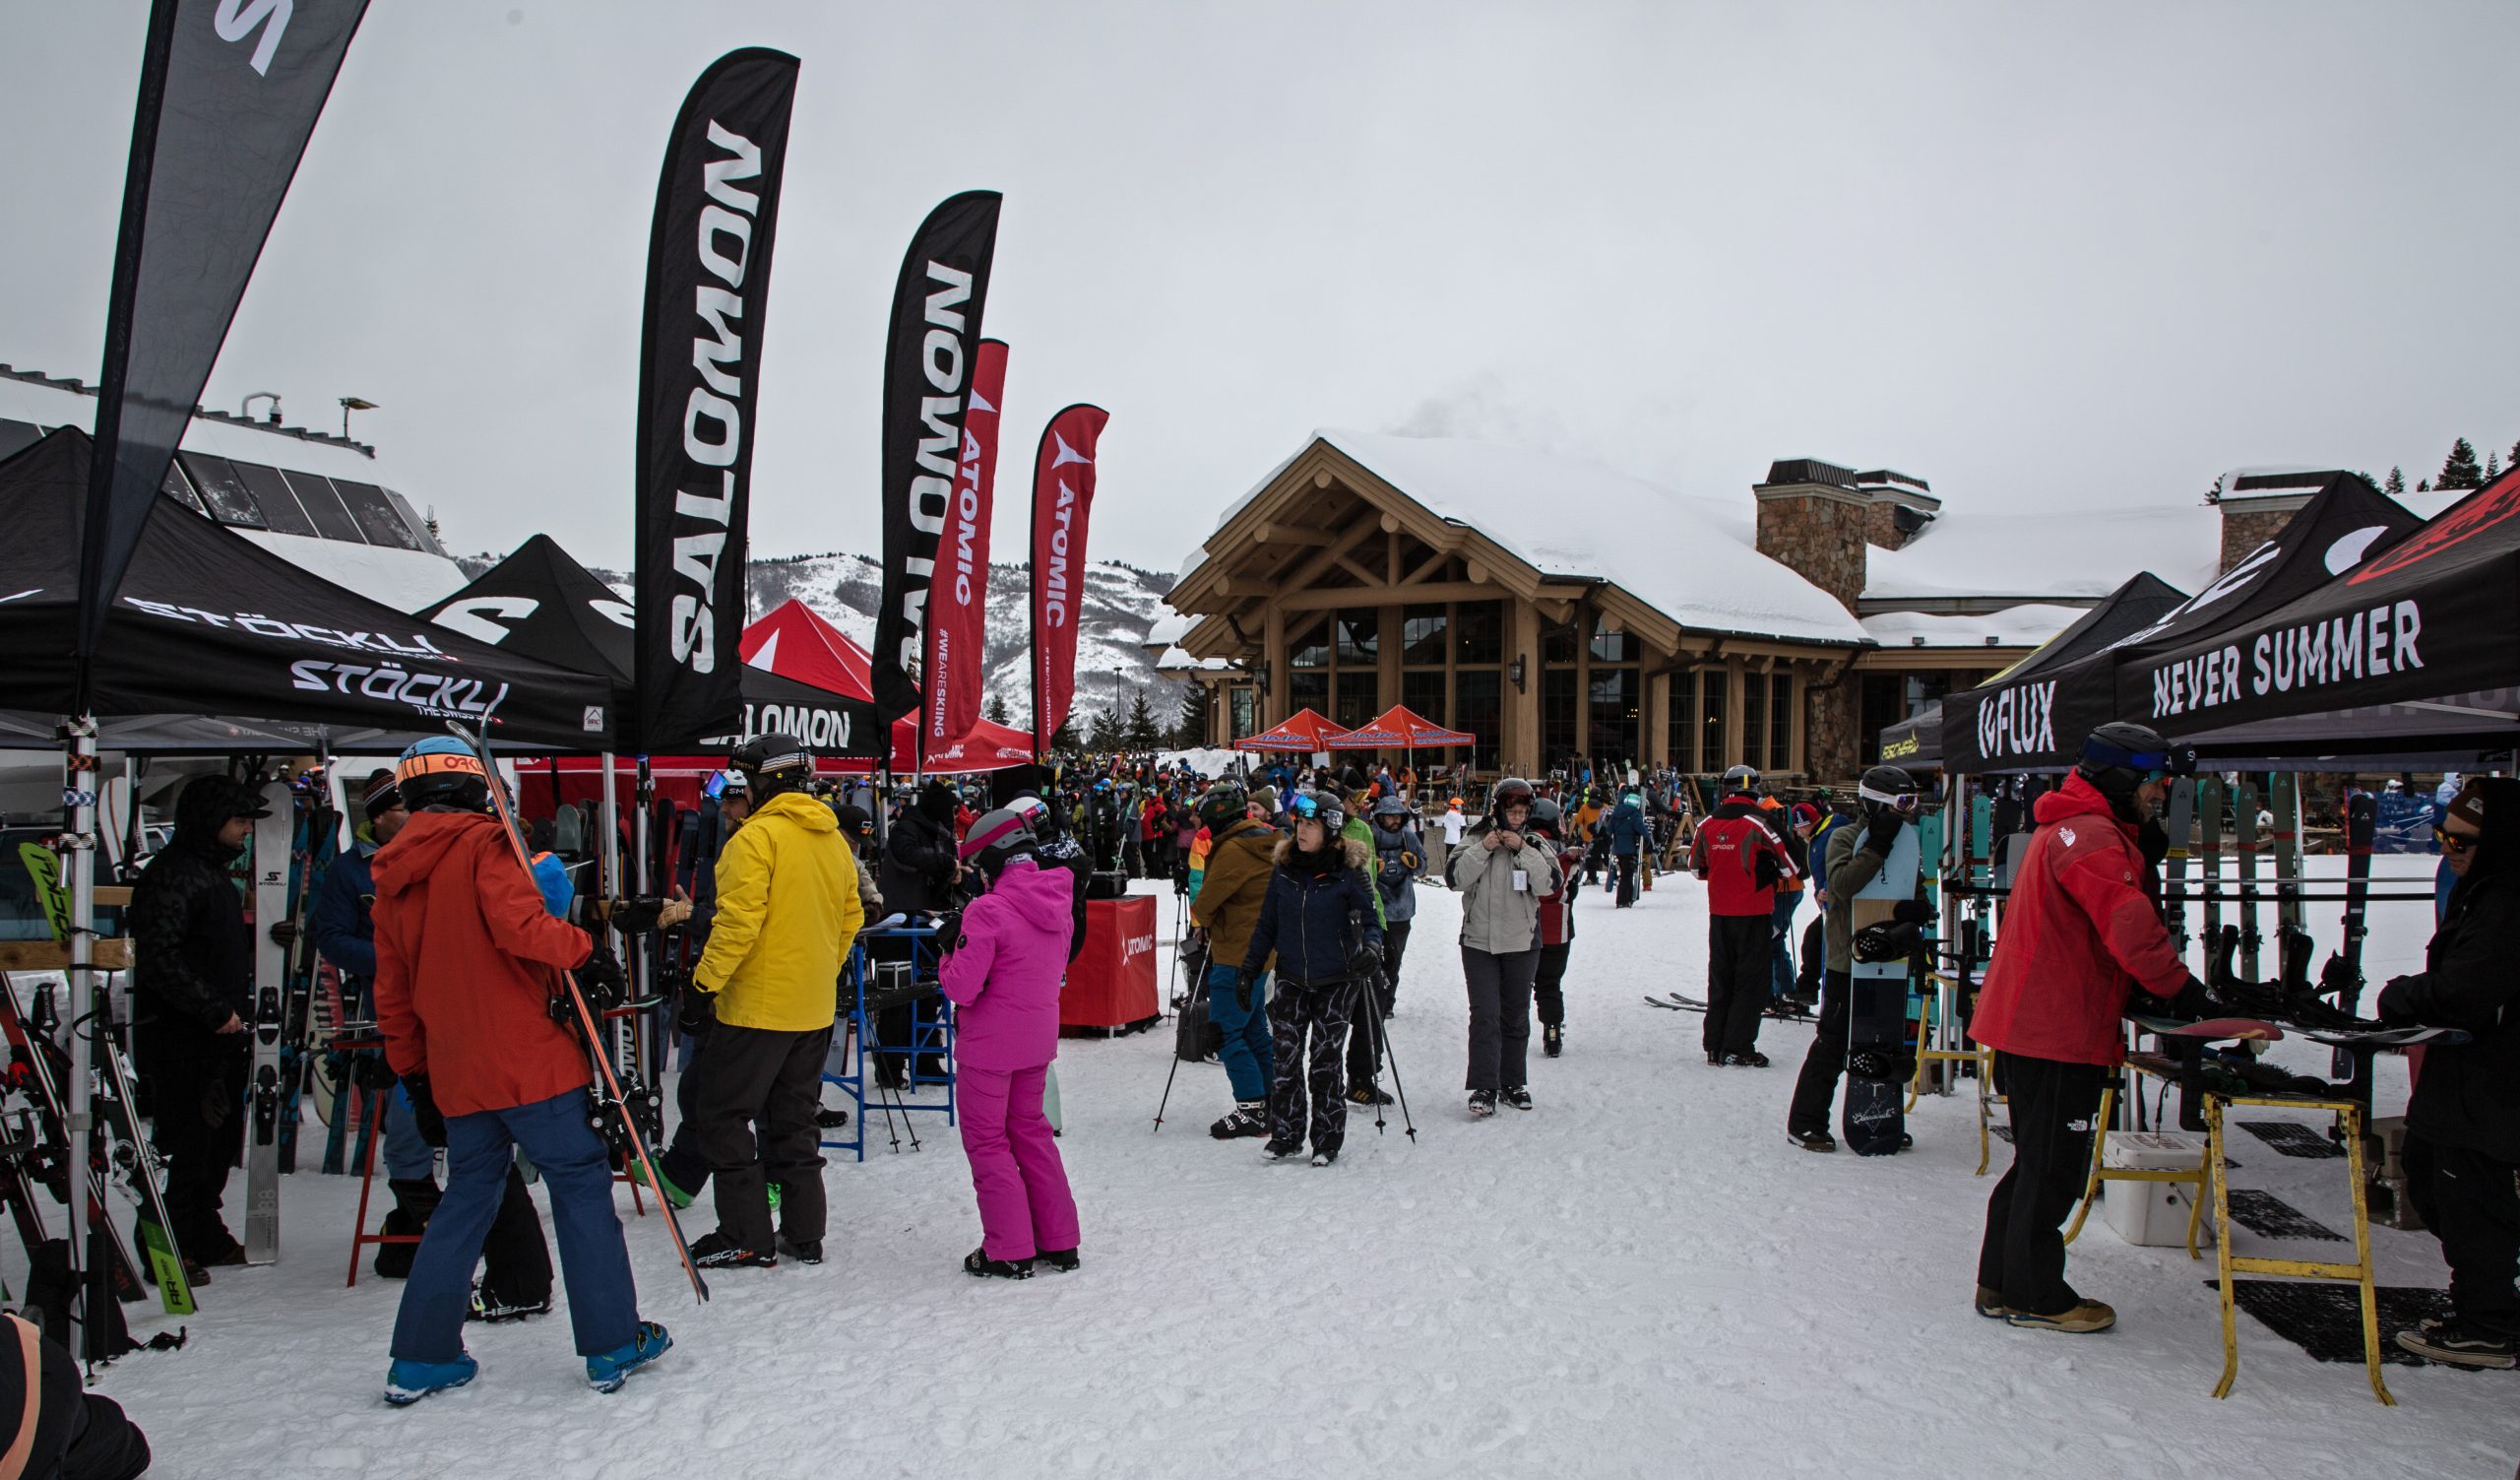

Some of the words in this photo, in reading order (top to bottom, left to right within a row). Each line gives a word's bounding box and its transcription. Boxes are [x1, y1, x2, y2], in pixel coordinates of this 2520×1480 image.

[671, 118, 762, 675] SALOMON
[955, 426, 983, 607] ATOMIC
[1045, 478, 1076, 628] ATOMIC
[124, 596, 445, 655] STÖCKLI
[2153, 645, 2241, 719] NEVER
[2253, 599, 2425, 695] SUMMER
[290, 659, 510, 712] STÖCKLI
[934, 628, 949, 738] #WEARESKIING
[699, 703, 850, 748] LOMON
[1995, 680, 2057, 757] FLUX
[443, 756, 483, 771] OAKL
[732, 758, 755, 770] SMITH
[30, 853, 69, 940] ÖCKLI
[1127, 933, 1153, 956] ATOMIC
[696, 1248, 746, 1265] FISCH
